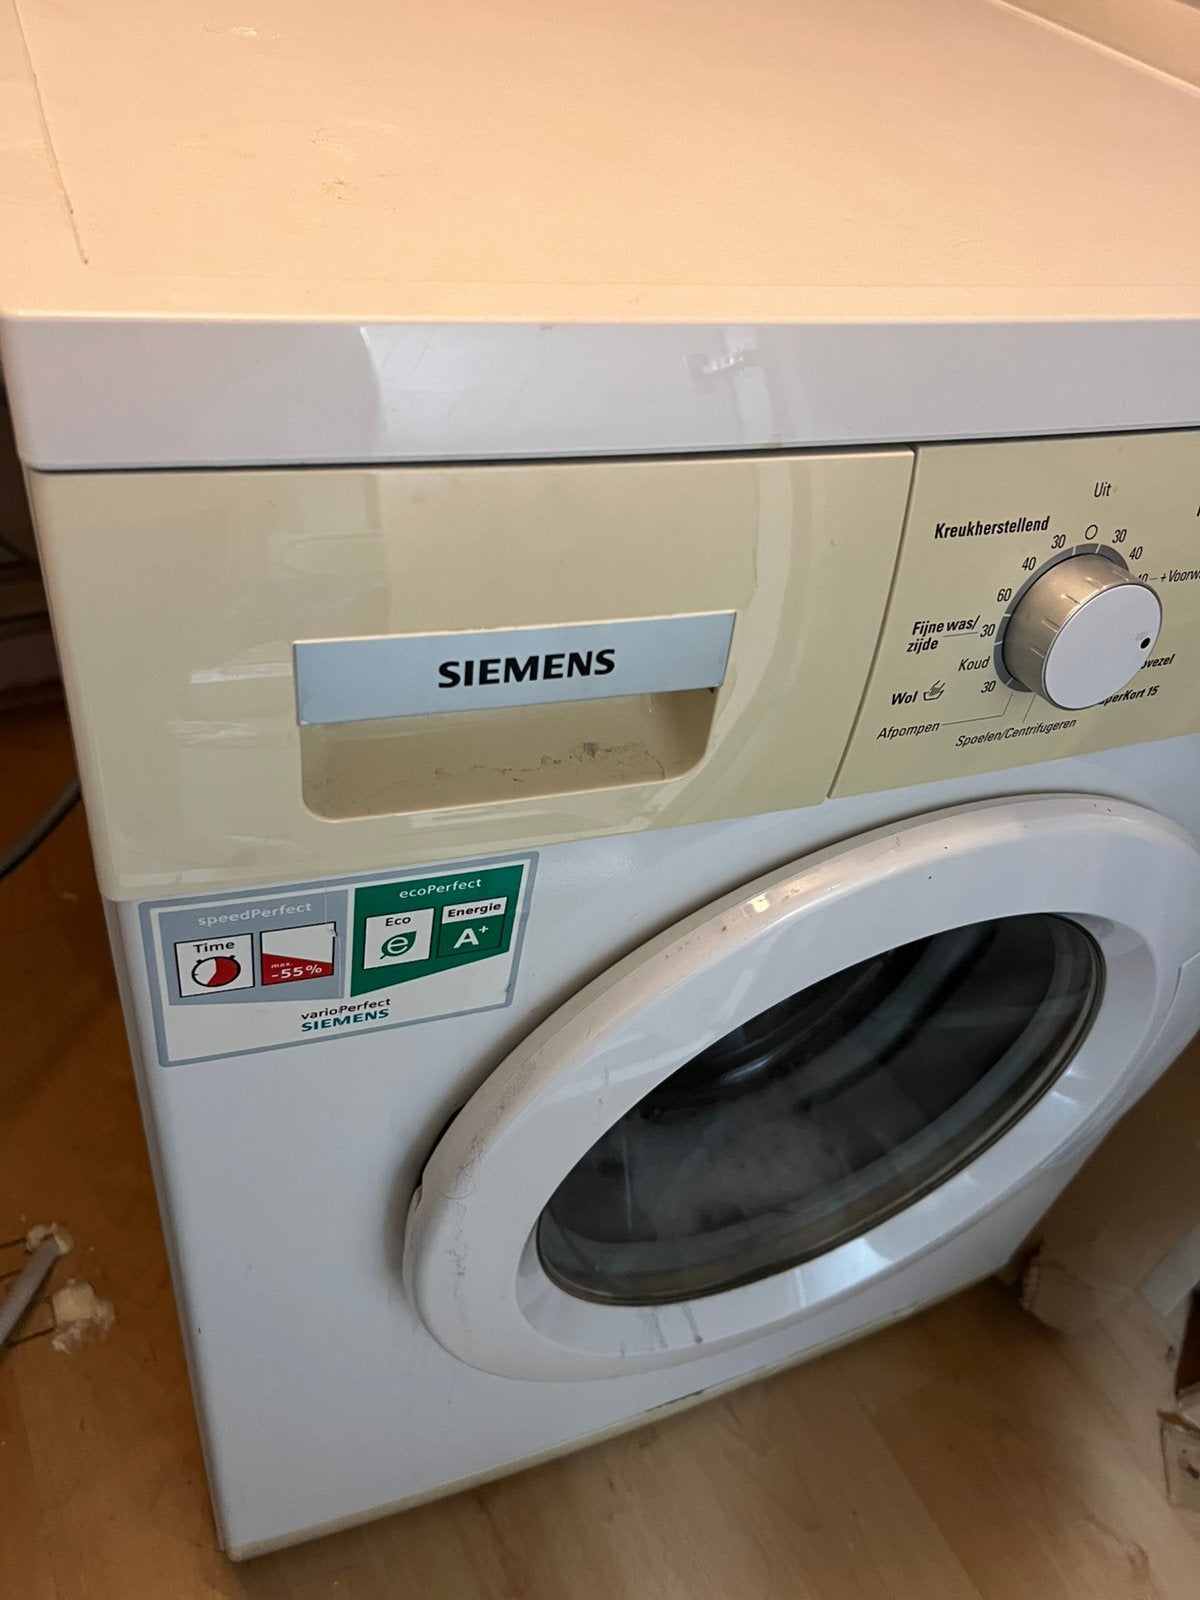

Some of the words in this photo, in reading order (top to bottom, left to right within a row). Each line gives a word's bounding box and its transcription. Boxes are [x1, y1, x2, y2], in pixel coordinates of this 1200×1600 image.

[1094, 482, 1111, 497] Uit
[934, 515, 1050, 539] Kreukherstellend
[1051, 534, 1066, 549] 30
[1112, 529, 1127, 543] 30
[1129, 546, 1143, 560] 40
[1022, 557, 1036, 571] 40
[997, 588, 1012, 602] 60
[912, 620, 944, 637] Fijne
[946, 615, 981, 632] was/
[980, 624, 995, 638] 30
[906, 638, 938, 654] zijde
[438, 649, 615, 688] SIEMENS
[958, 656, 991, 672] Koud
[981, 680, 996, 694] 30
[891, 691, 918, 705] Wol
[1098, 688, 1146, 707] perKort
[1147, 685, 1160, 697] 15
[876, 721, 940, 740] Afpompen
[955, 719, 1077, 748] Spoelen/Centrifugeren
[399, 878, 482, 899] ecoPerfect
[198, 902, 312, 927] speedPerfect
[447, 902, 502, 918] Energie
[385, 915, 411, 927] Eco
[193, 940, 235, 954] Time
[301, 998, 391, 1020] varioPerfect
[301, 1008, 389, 1032] SIEMENS
